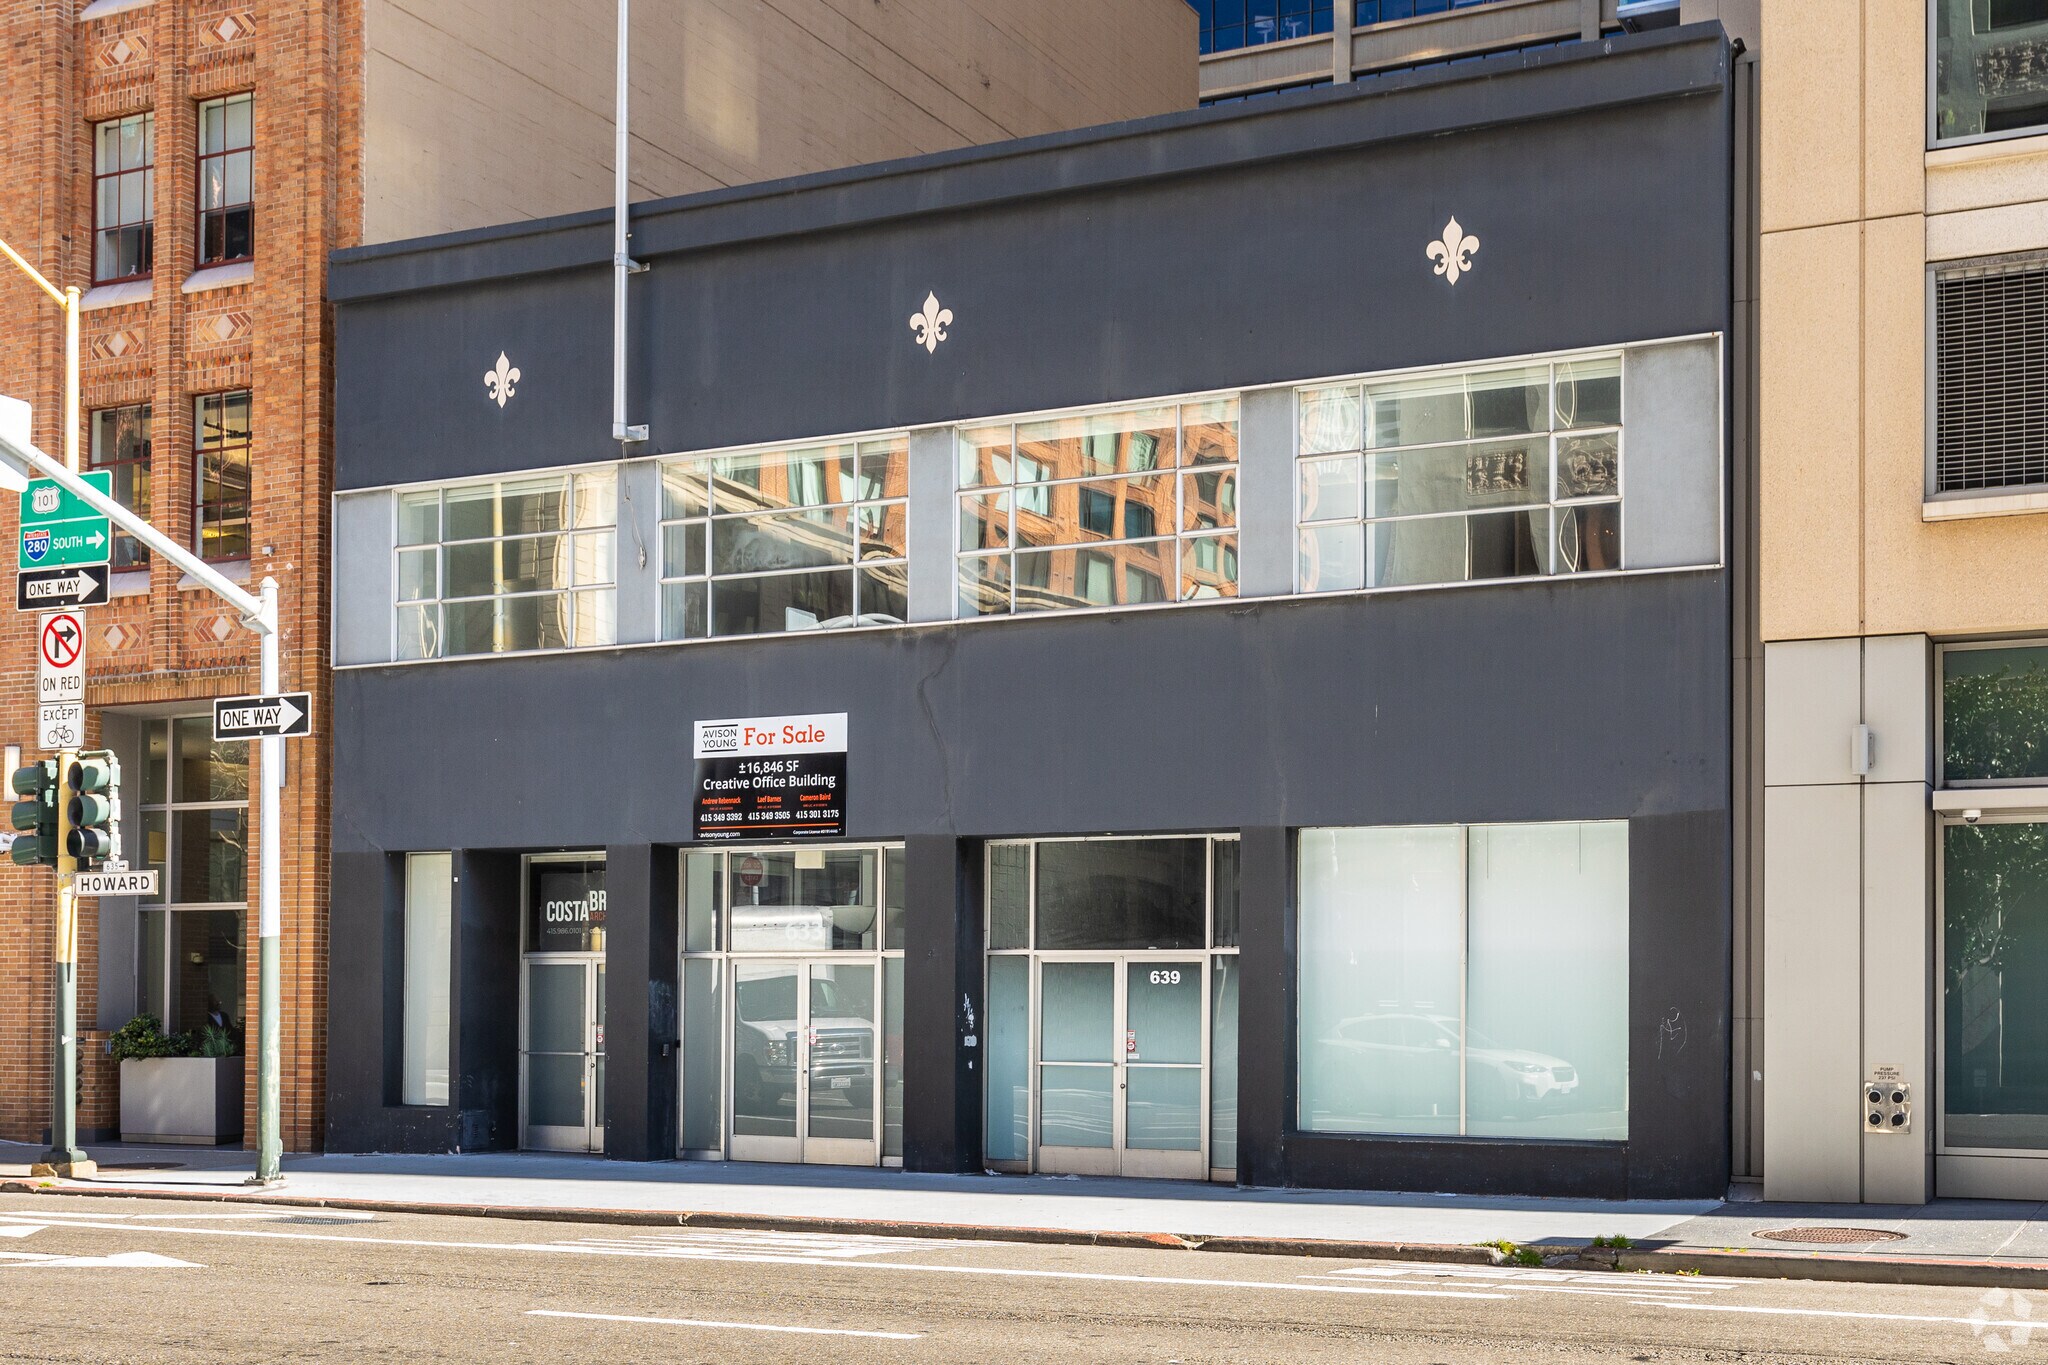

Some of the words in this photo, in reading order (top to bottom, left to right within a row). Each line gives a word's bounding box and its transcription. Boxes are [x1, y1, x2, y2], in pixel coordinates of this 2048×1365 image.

[38, 494, 53, 507] 101
[27, 540, 47, 553] 280
[53, 536, 83, 550] SOUTH
[29, 582, 52, 596] ONE
[57, 580, 80, 593] WAY
[43, 677, 56, 691] ON
[61, 676, 80, 690] RED
[43, 708, 79, 721] EXCEPT
[223, 710, 249, 727] ONE
[253, 707, 281, 725] WAY
[703, 729, 737, 739] AVISON
[744, 727, 776, 746] For
[782, 724, 825, 745] Sale
[703, 739, 737, 748] YOUNG
[738, 761, 784, 775] ±16,846
[786, 760, 800, 772] SF
[703, 778, 750, 790] Creative
[752, 776, 786, 788] Office
[789, 774, 836, 788] Building
[700, 813, 712, 821] 415
[713, 813, 725, 821] 349
[748, 812, 760, 820] 415
[761, 811, 774, 820] 349
[774, 811, 791, 820] 3505
[796, 810, 808, 818] 415
[809, 810, 821, 818] 301
[822, 809, 840, 818] 3175
[81, 876, 150, 892] HOWARD
[546, 900, 590, 922] COSTA
[1150, 970, 1181, 984] 639
